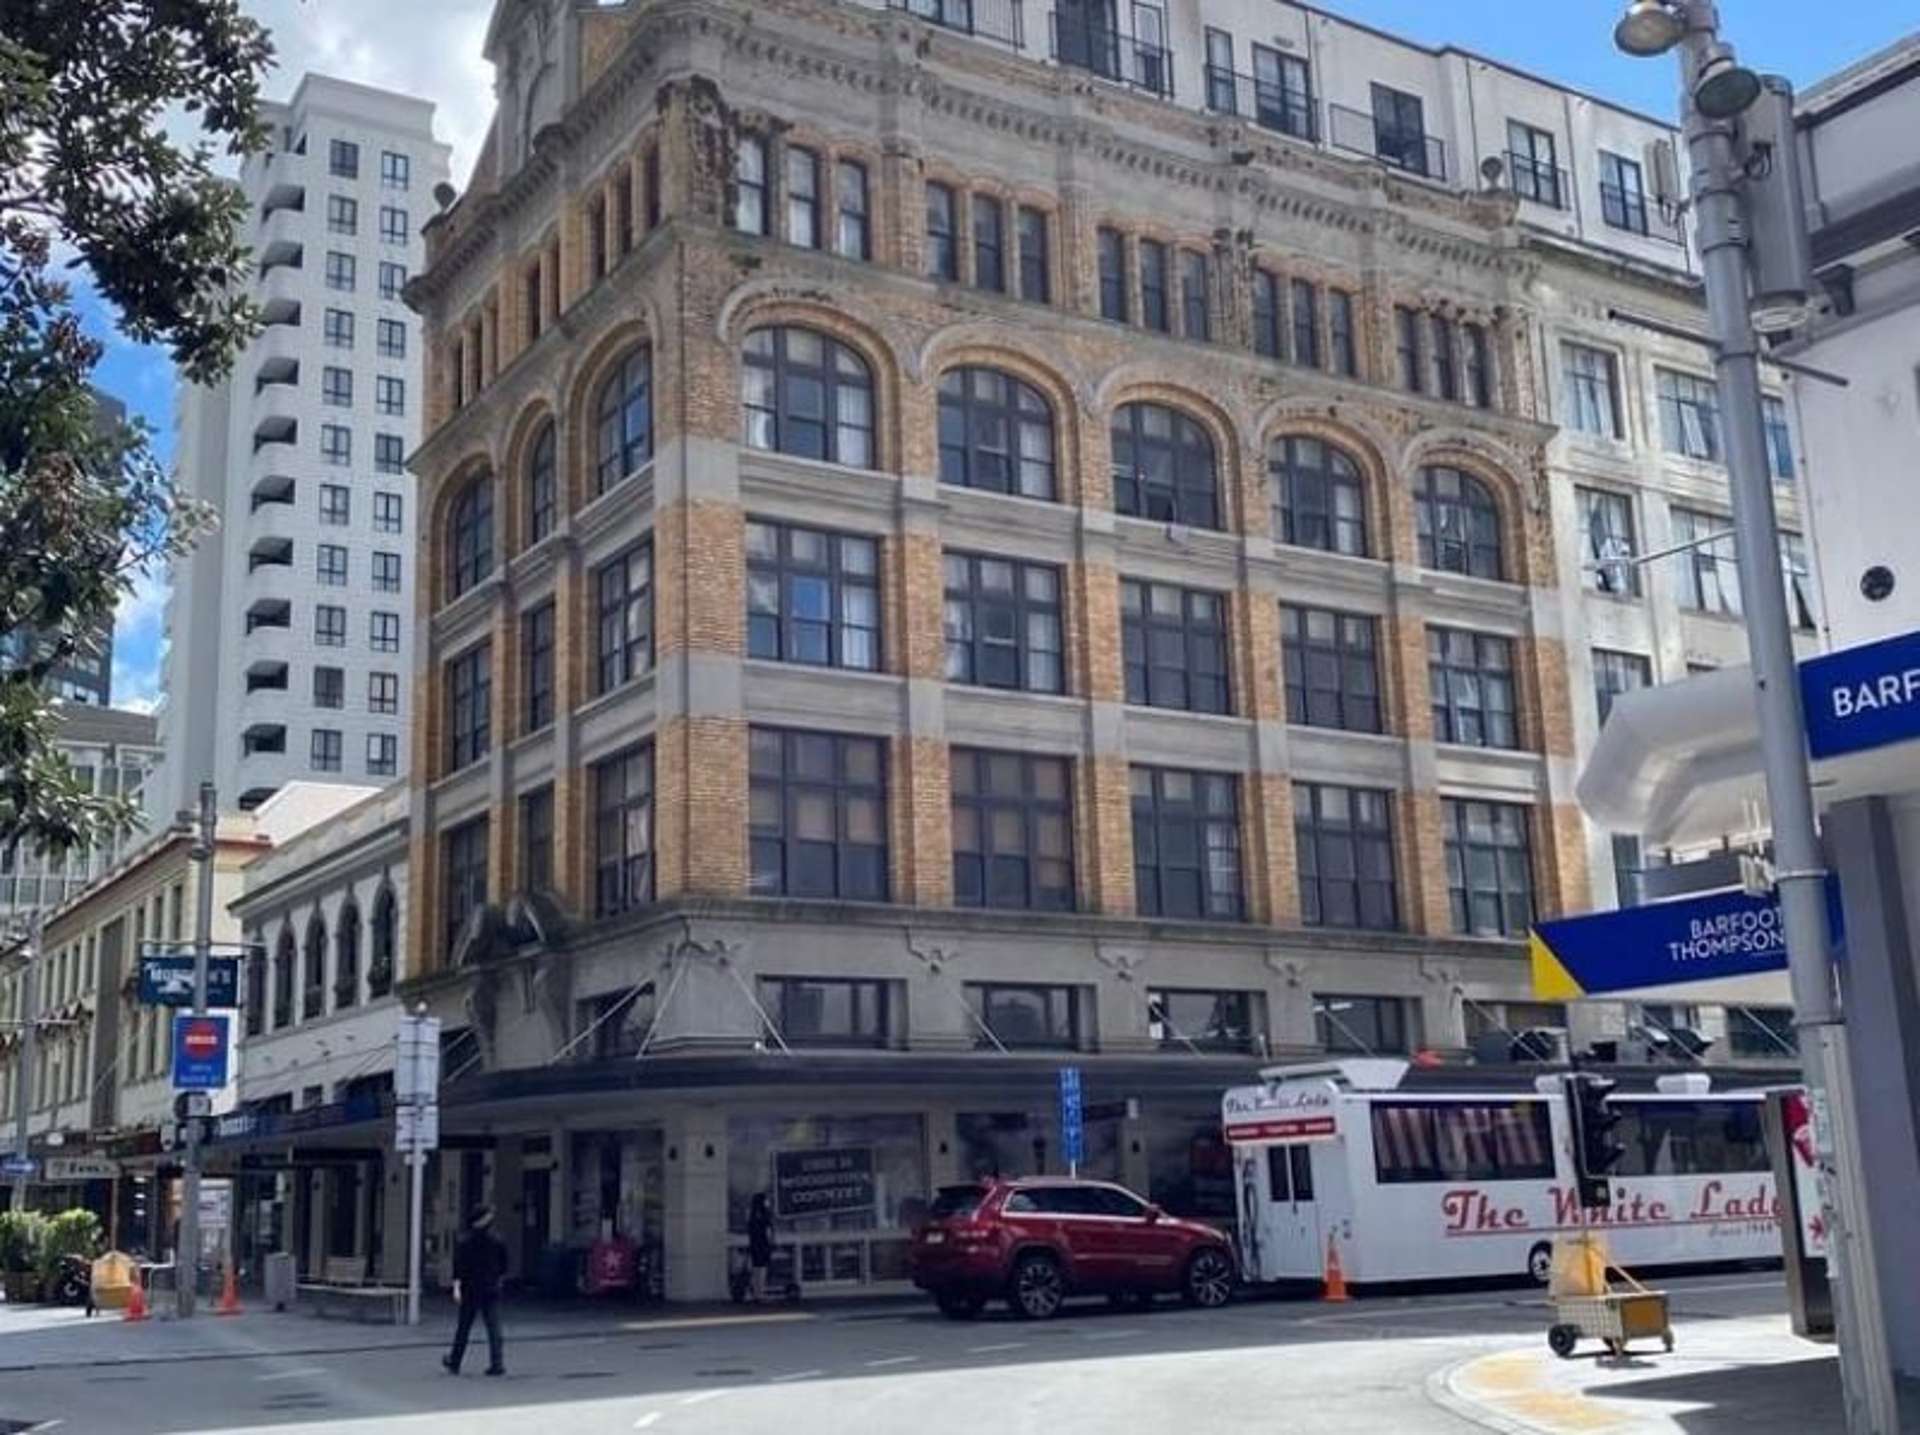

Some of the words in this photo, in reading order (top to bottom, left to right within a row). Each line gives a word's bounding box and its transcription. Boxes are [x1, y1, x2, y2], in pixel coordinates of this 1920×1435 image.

[1832, 667, 1920, 718] BARF
[1690, 906, 1784, 940] BARFOOT
[1668, 928, 1785, 961] THOMPSON
[1442, 1189, 1529, 1231] The
